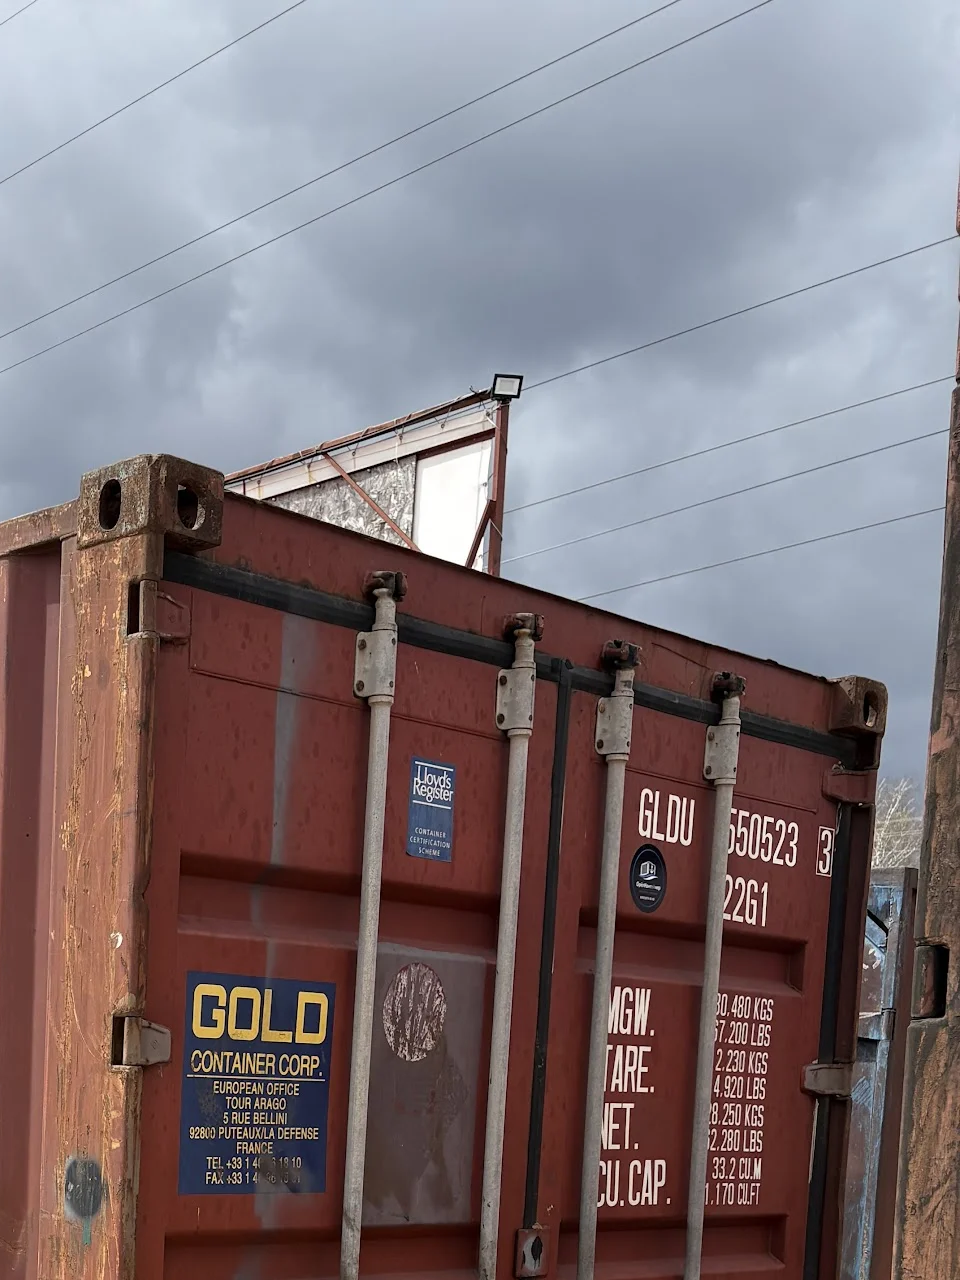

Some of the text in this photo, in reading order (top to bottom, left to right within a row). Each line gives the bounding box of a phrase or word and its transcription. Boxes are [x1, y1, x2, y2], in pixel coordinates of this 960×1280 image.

[417, 765, 451, 789] Lloyd's
[413, 778, 454, 802] Register
[409, 836, 451, 849] CERTIFICATION
[414, 827, 446, 839] CONTAINER
[638, 788, 695, 846] GLDU
[818, 828, 833, 875] 3
[418, 847, 441, 857] SCHEME
[722, 874, 769, 927] 22G1
[192, 983, 329, 1045] GOLD
[753, 997, 774, 1021] KGS
[750, 1023, 772, 1047] LBS
[190, 1050, 323, 1077] CONTAINER CORP.
[747, 1051, 769, 1075] KGS
[213, 1081, 300, 1096] EUROPEAN OFFICE
[746, 1077, 767, 1100] LBS
[225, 1096, 287, 1110] TOUR ARAGO
[223, 1112, 288, 1125] 5 RUE BELLINI
[744, 1104, 765, 1127] KGS
[189, 1126, 319, 1140] 92800 PUTEAUX/LA DEFENSE
[742, 1129, 763, 1153] LBS
[236, 1141, 274, 1154] FRANCE
[226, 1157, 242, 1169] +33
[245, 1157, 249, 1169] 1
[291, 1156, 302, 1169] 10
[712, 1157, 736, 1180] 33.2
[738, 1157, 762, 1180] CU.M
[205, 1172, 224, 1184] FAX
[226, 1171, 242, 1184] +33
[245, 1171, 250, 1184] 1
